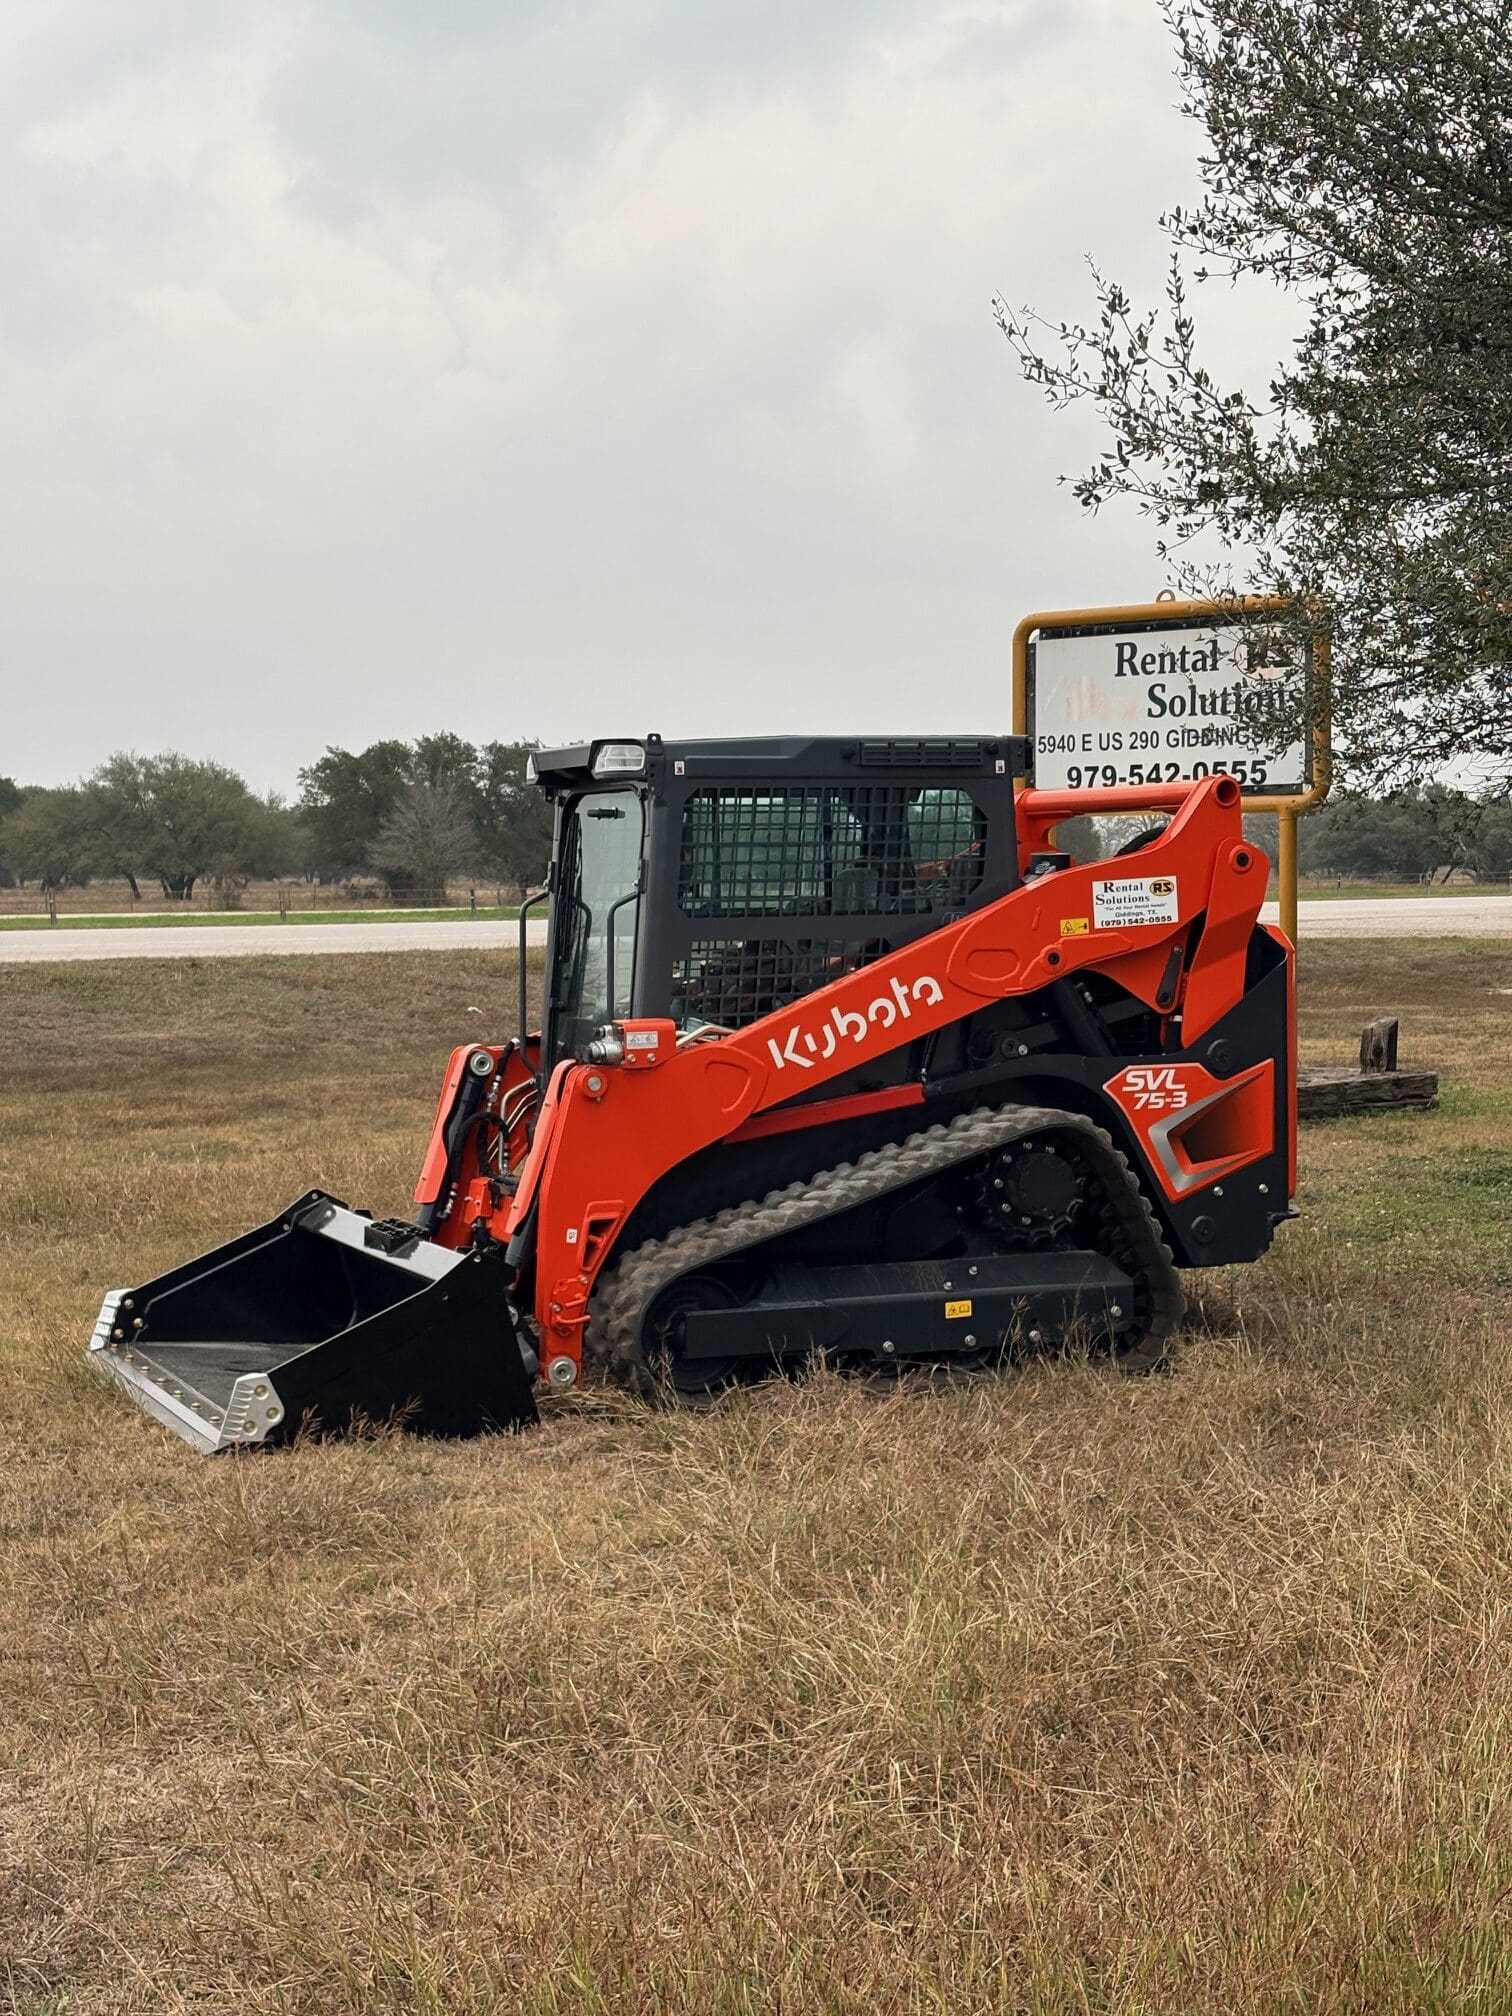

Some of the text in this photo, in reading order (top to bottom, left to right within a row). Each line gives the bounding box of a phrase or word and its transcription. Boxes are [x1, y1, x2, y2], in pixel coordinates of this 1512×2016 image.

[1115, 639, 1220, 677] Rental
[1038, 734, 1075, 754] 5940
[1082, 734, 1092, 751] E
[1099, 732, 1123, 751] US
[1129, 731, 1159, 750] 290
[1103, 882, 1143, 893] Rental
[1153, 881, 1173, 893] RS
[1095, 894, 1150, 906] Solutions
[767, 976, 944, 1069] Kubota
[1122, 1069, 1186, 1092] SVL
[1133, 1091, 1188, 1110] 75-3
